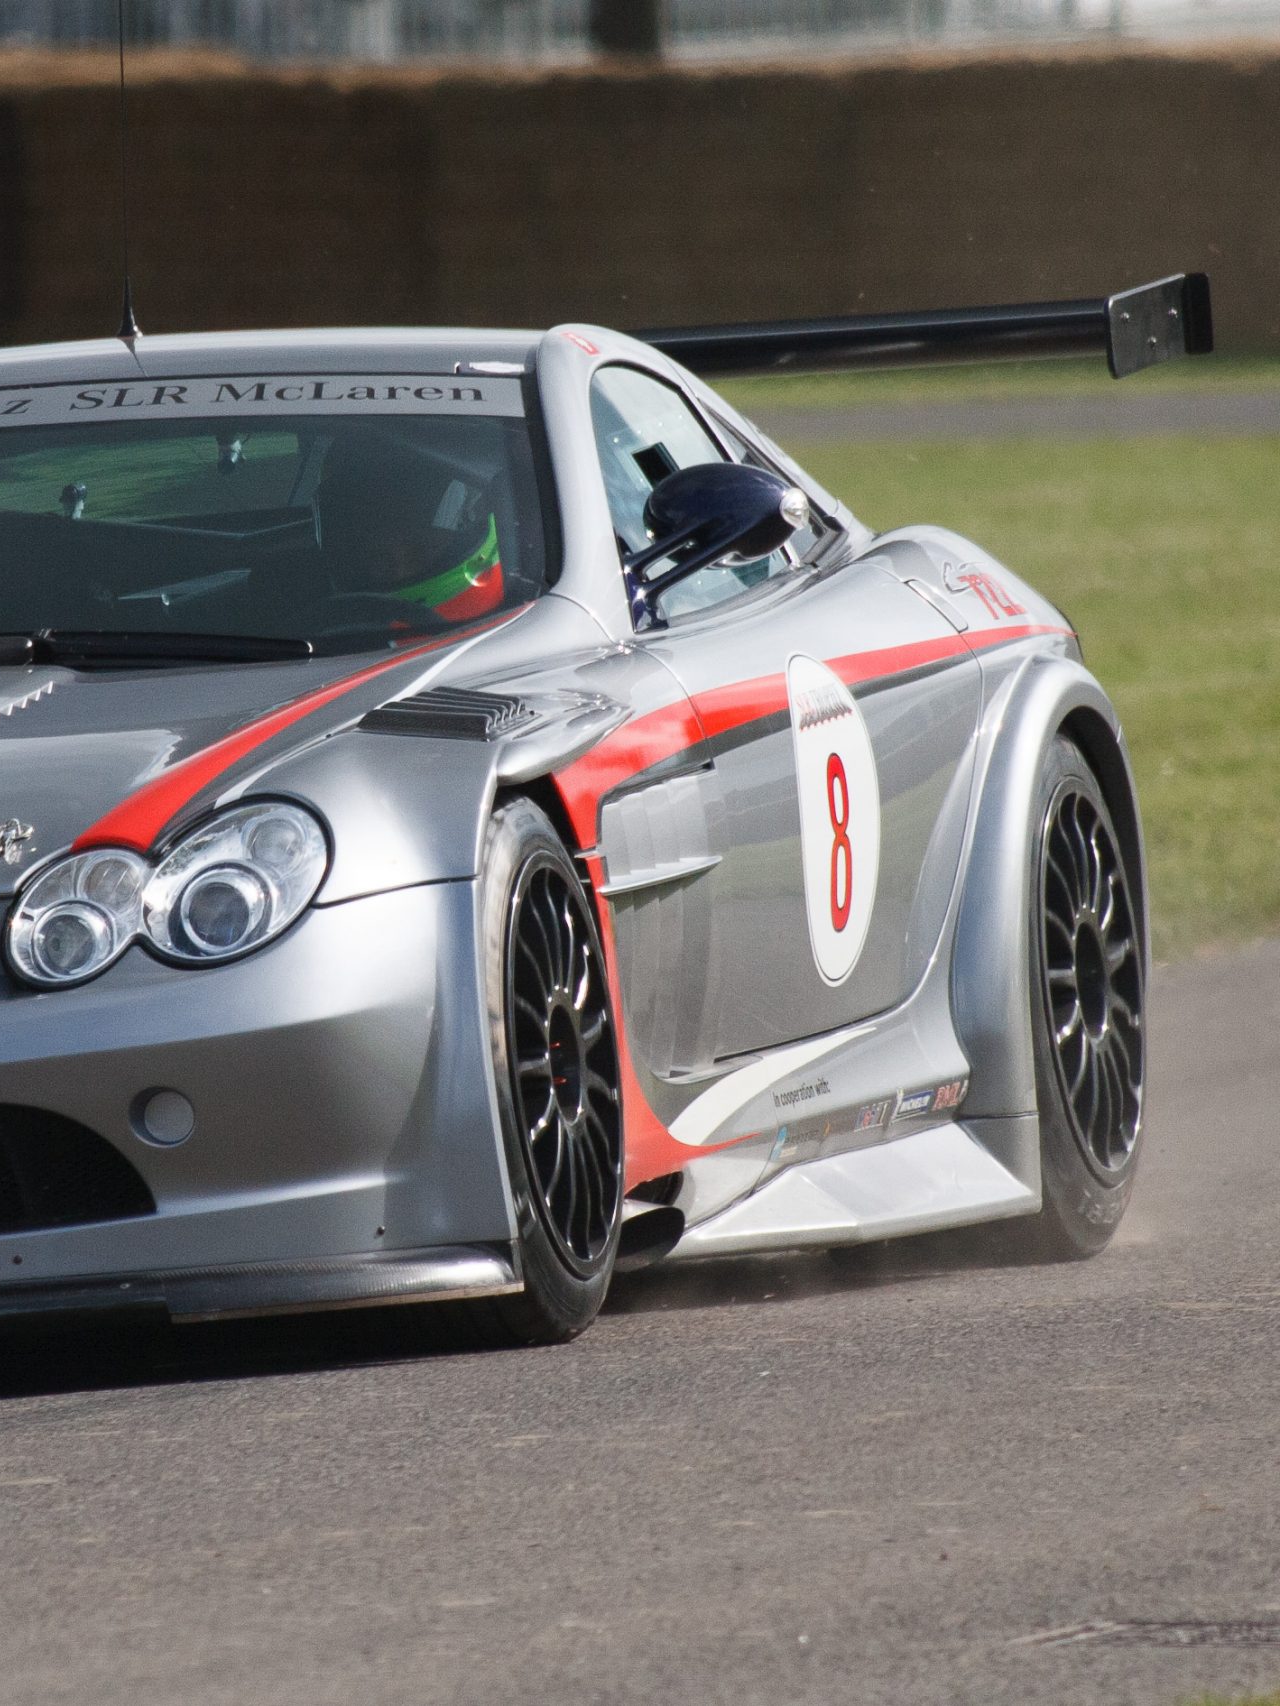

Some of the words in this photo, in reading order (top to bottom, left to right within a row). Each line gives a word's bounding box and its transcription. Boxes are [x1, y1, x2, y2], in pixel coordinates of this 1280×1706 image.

[69, 384, 188, 411] SLR
[215, 380, 488, 402] McLaren
[826, 752, 853, 933] 8
[780, 1082, 816, 1108] cooperation
